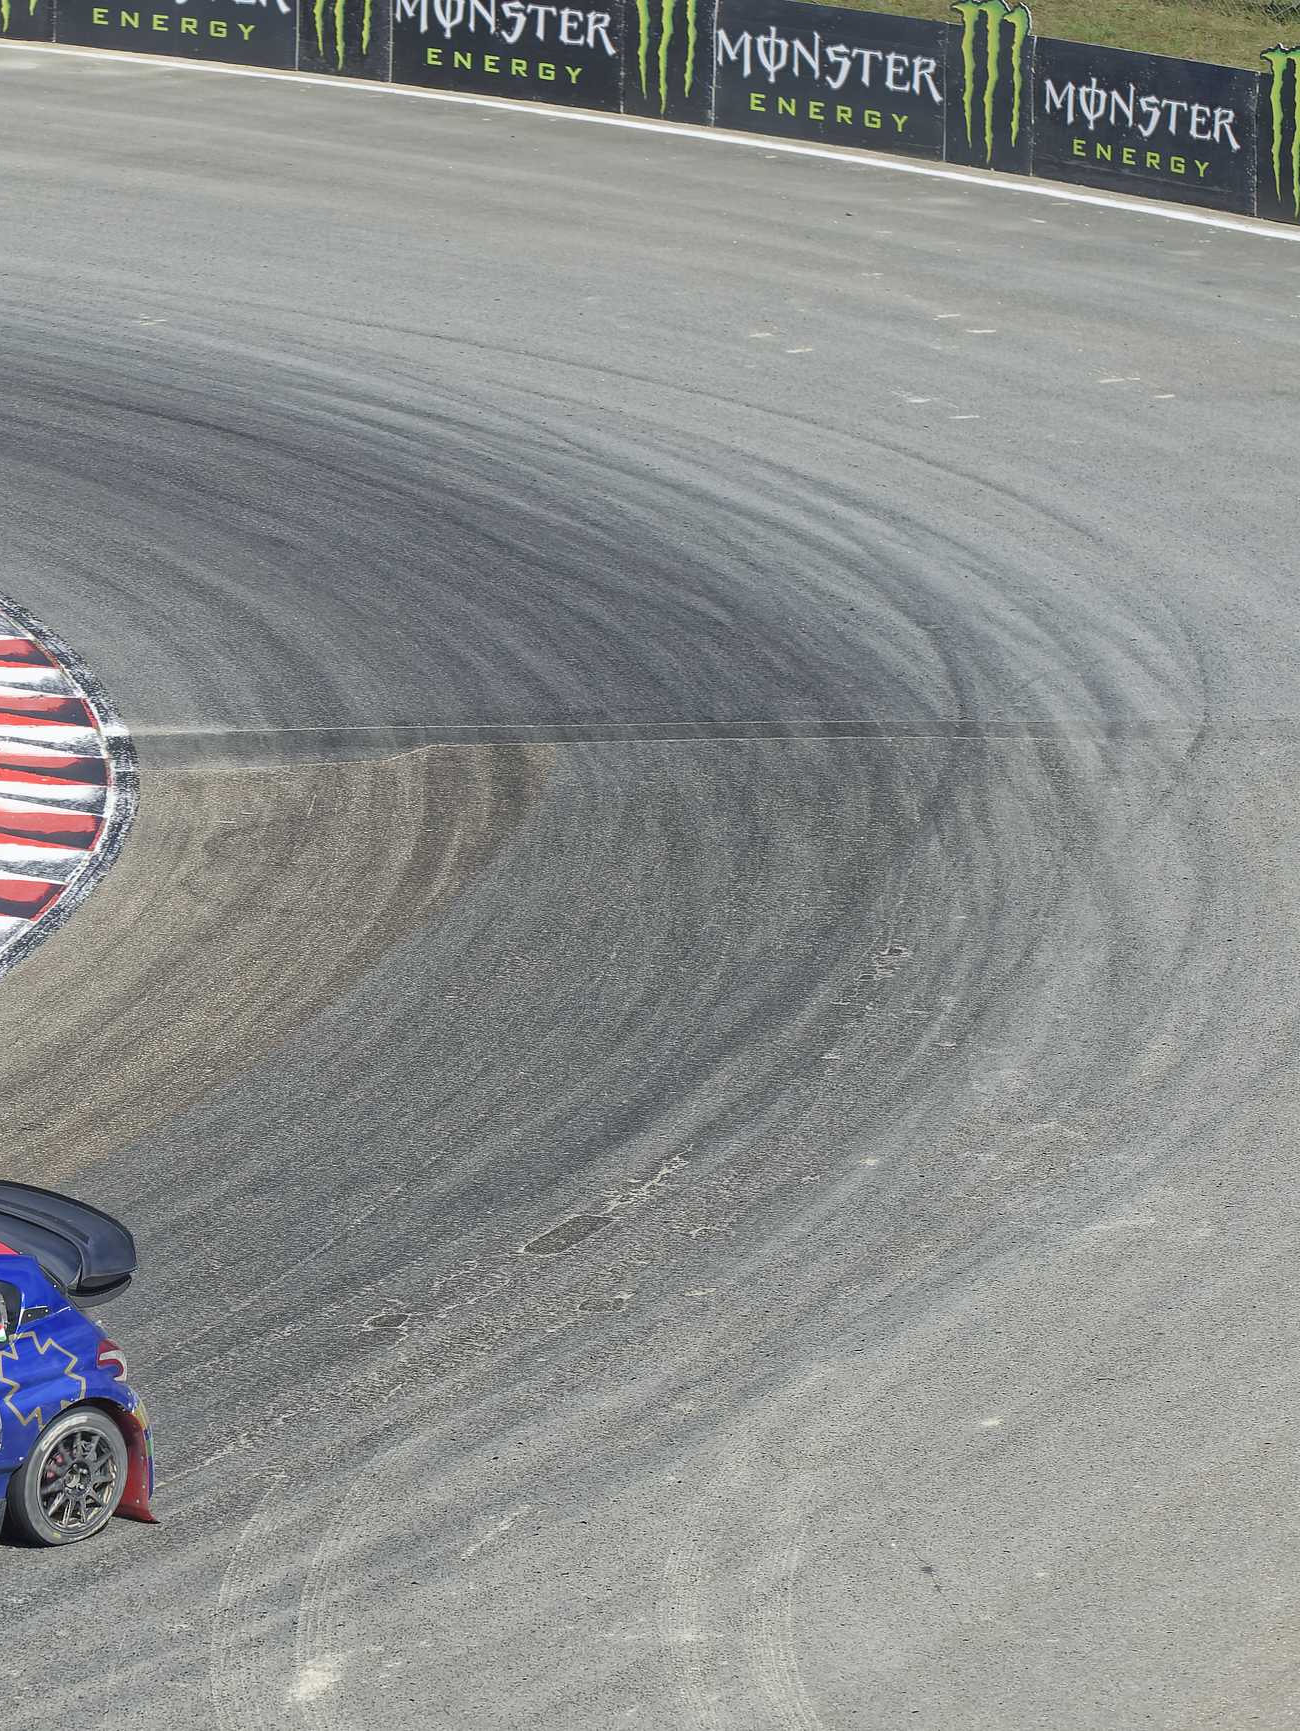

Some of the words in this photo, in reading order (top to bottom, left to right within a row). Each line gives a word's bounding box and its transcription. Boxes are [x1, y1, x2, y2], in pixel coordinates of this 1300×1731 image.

[91, 7, 256, 41] ENERGY
[426, 47, 583, 84] ENERGY
[716, 26, 944, 104] MONSTER
[749, 92, 909, 133] ENERGY
[1044, 77, 1241, 152] MONSTER
[1072, 138, 1211, 177] ENERGY
